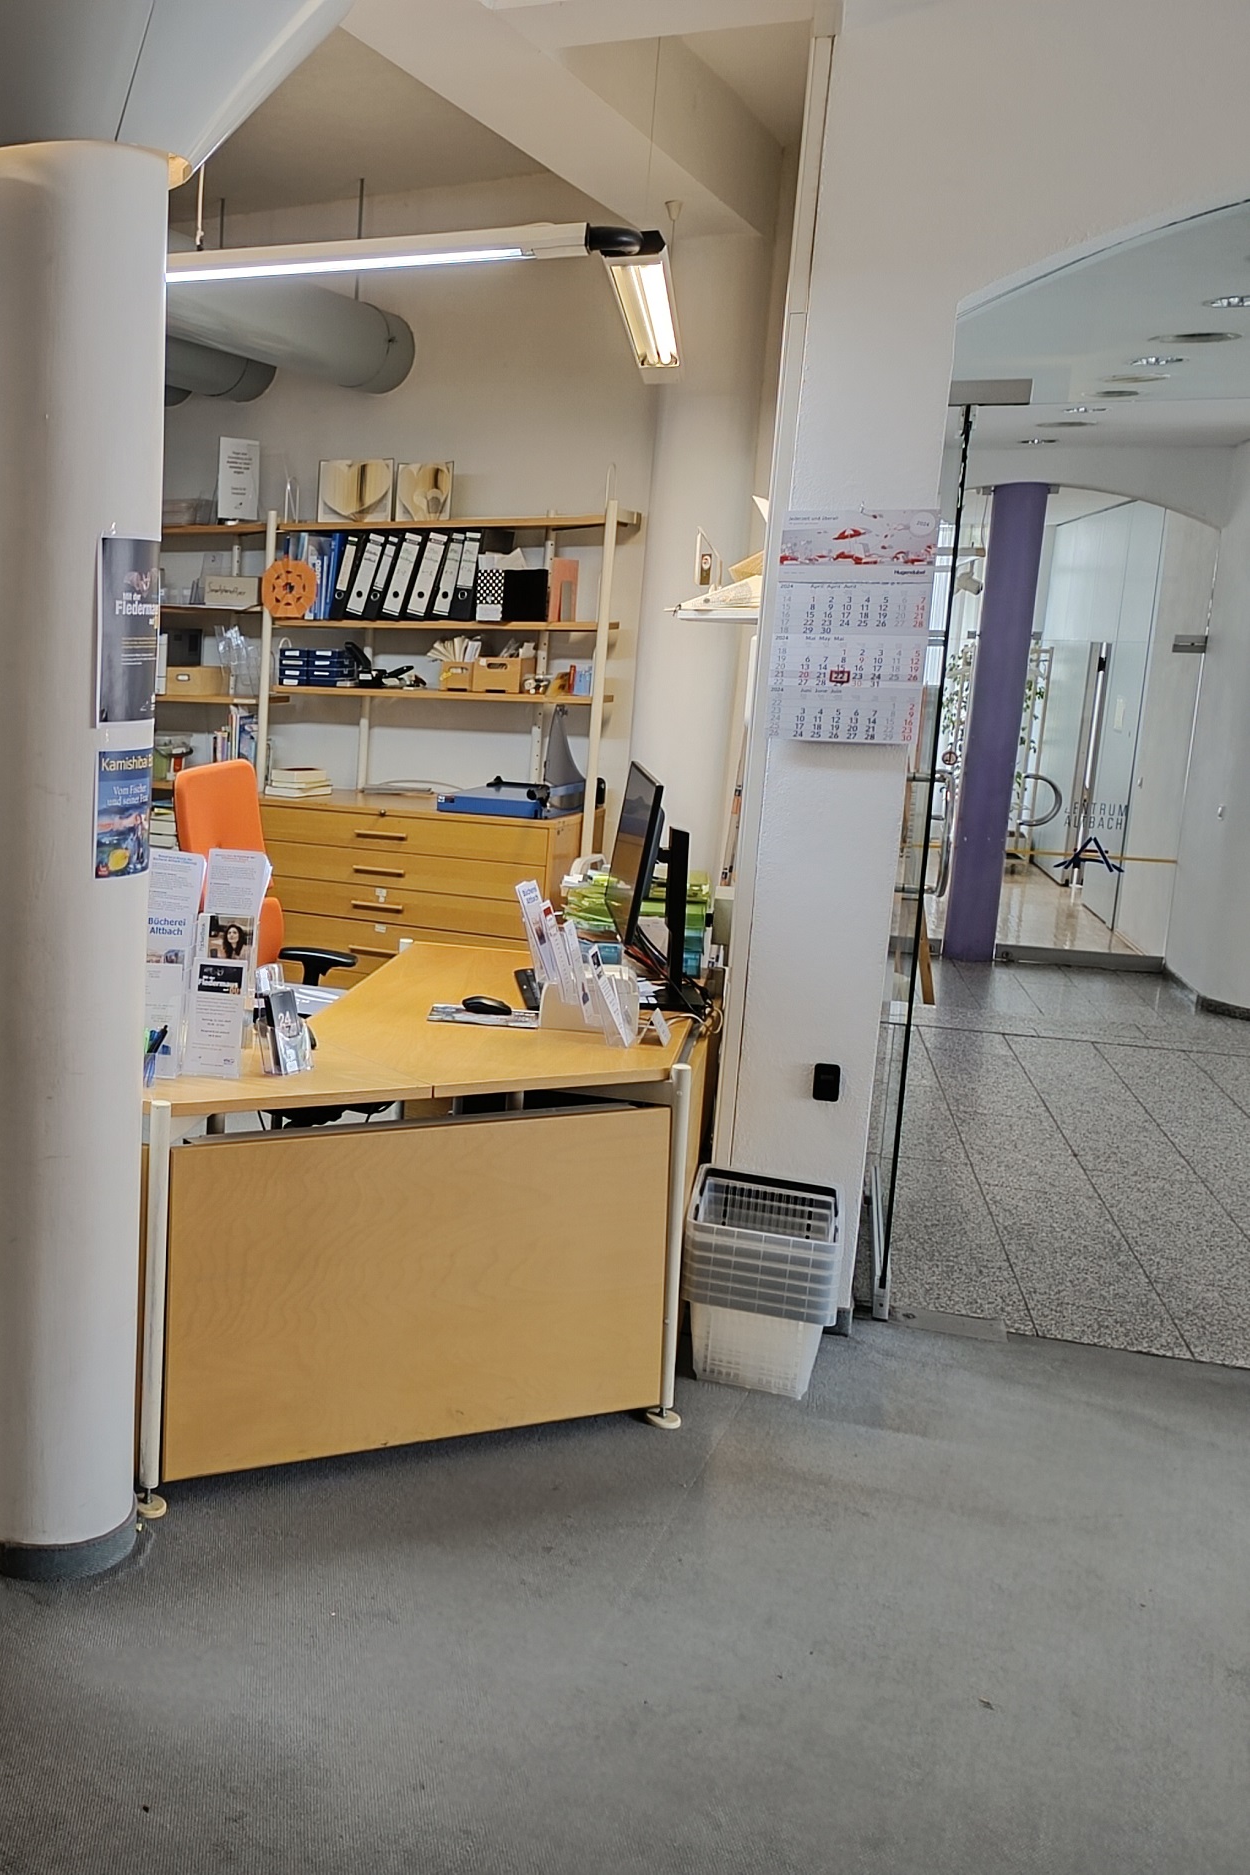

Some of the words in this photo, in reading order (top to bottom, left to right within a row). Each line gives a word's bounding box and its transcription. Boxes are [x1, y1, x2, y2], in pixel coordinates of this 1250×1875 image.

[101, 754, 147, 771] Kamishibai
[113, 786, 128, 795] Vom
[107, 796, 121, 806] und
[1064, 815, 1123, 830] ALTBACH
[148, 916, 186, 925] Bücherei
[150, 927, 183, 935] Altbach
[278, 1011, 291, 1025] 24
